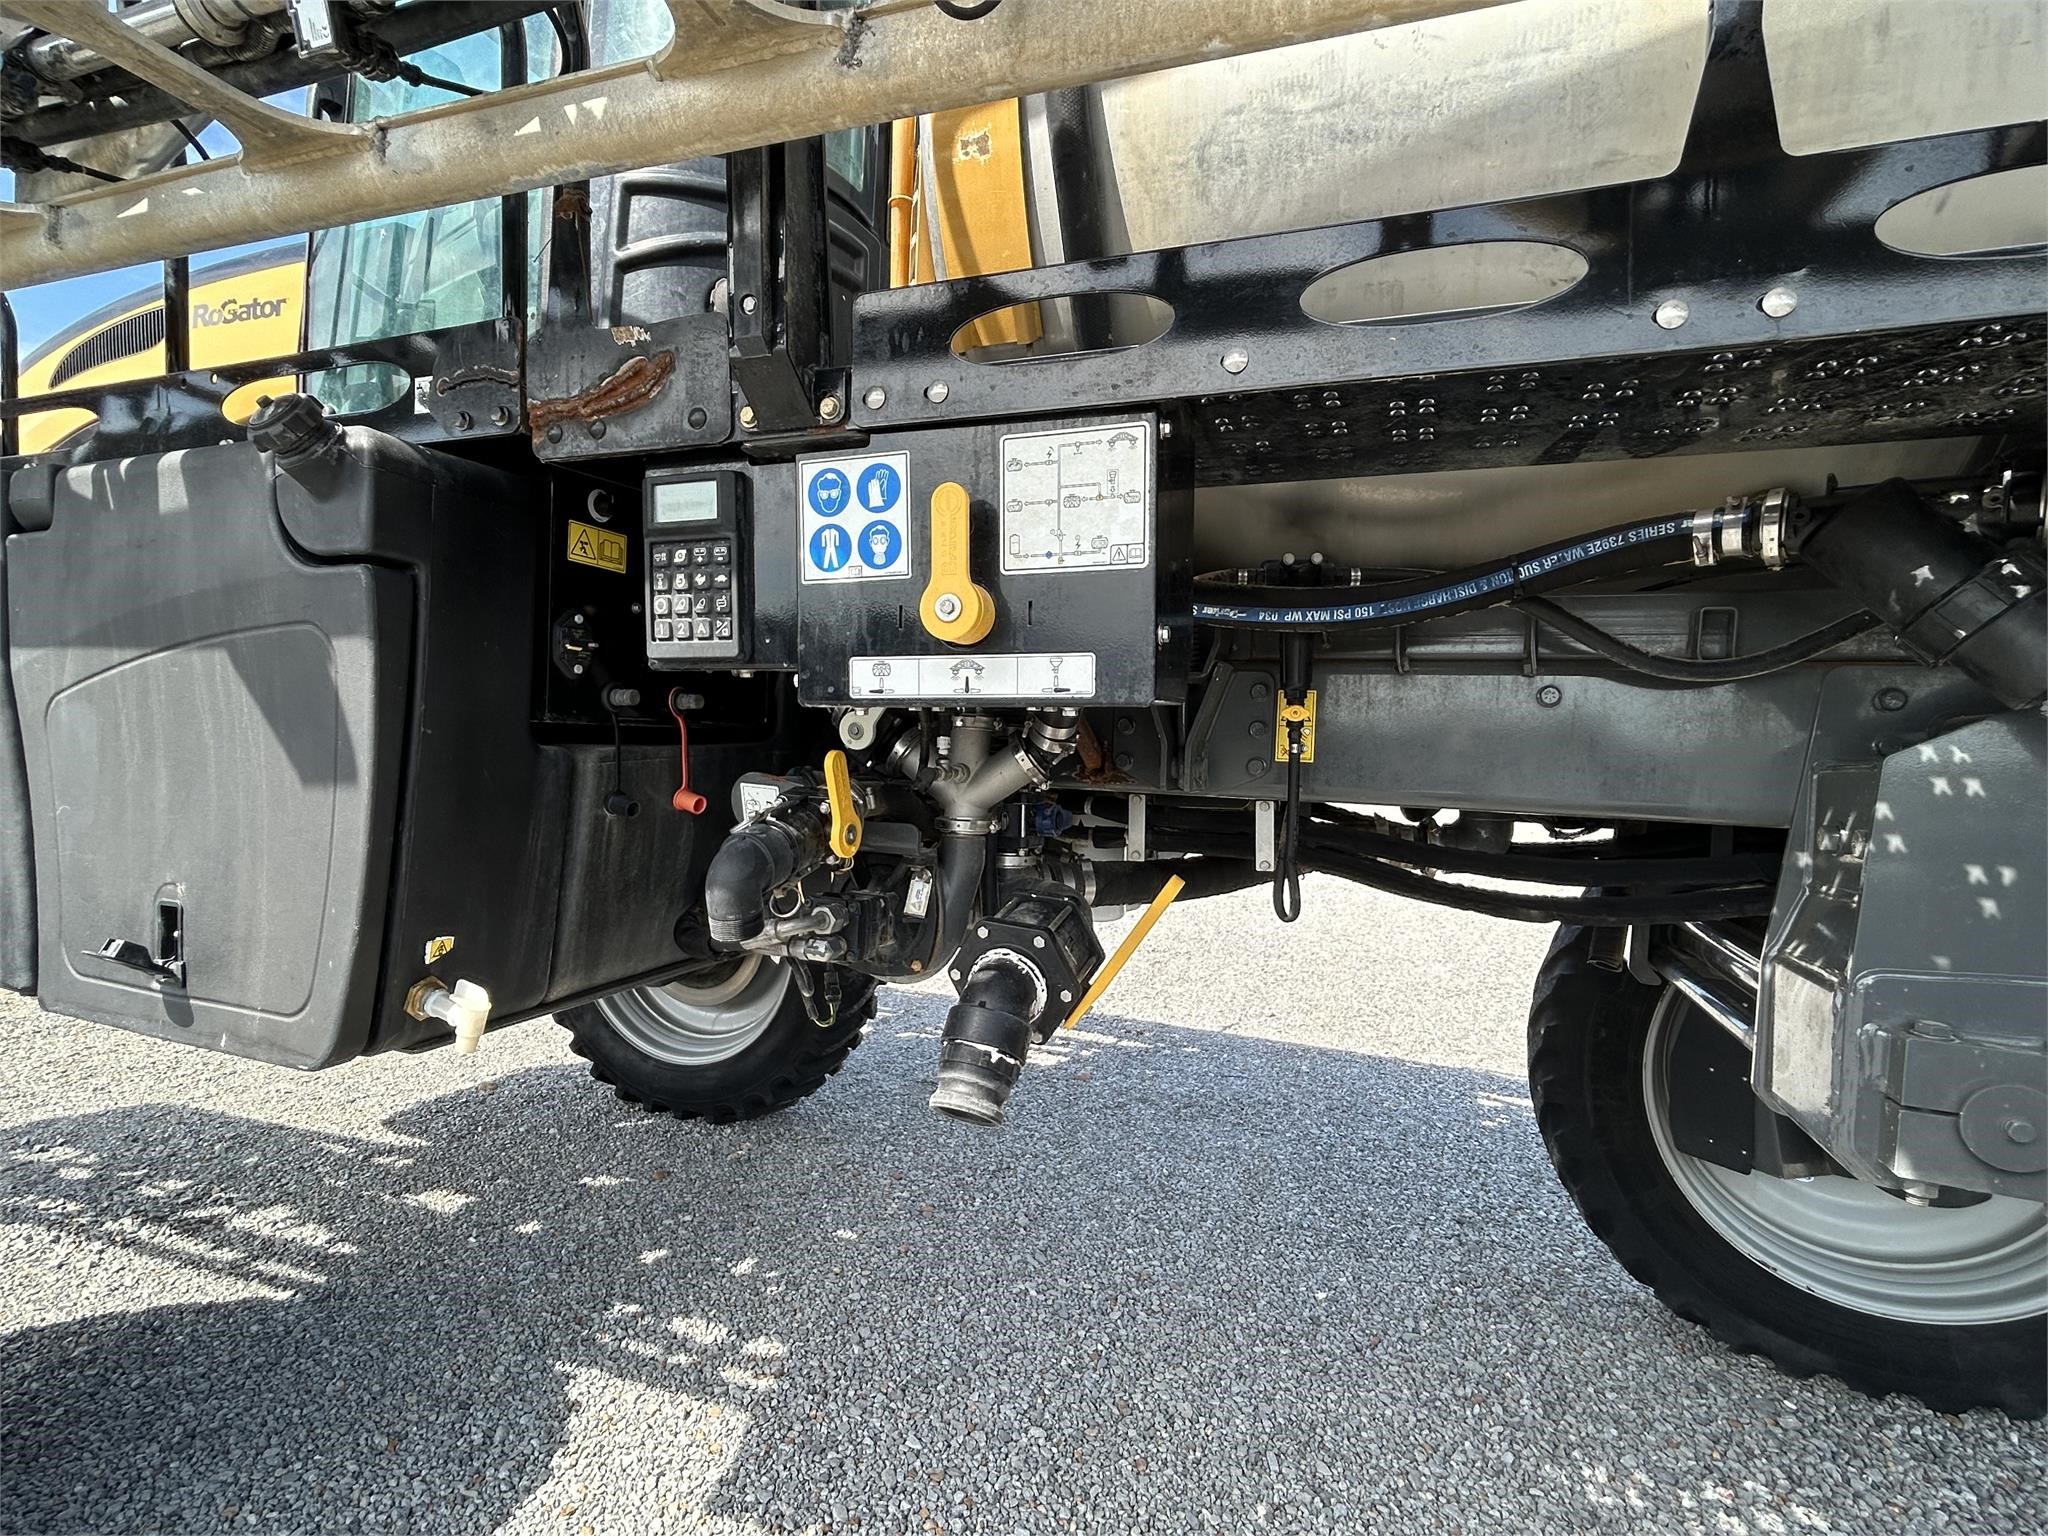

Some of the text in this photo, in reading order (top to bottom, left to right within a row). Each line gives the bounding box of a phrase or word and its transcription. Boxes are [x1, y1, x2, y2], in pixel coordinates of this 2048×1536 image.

[192, 297, 288, 329] RoGator
[1628, 522, 1675, 543] SERIES
[1587, 534, 1625, 555] 7392E
[1284, 610, 1303, 621] WP
[1305, 610, 1331, 621] MAX
[1332, 608, 1351, 621] PSI
[1354, 605, 1374, 618] 150
